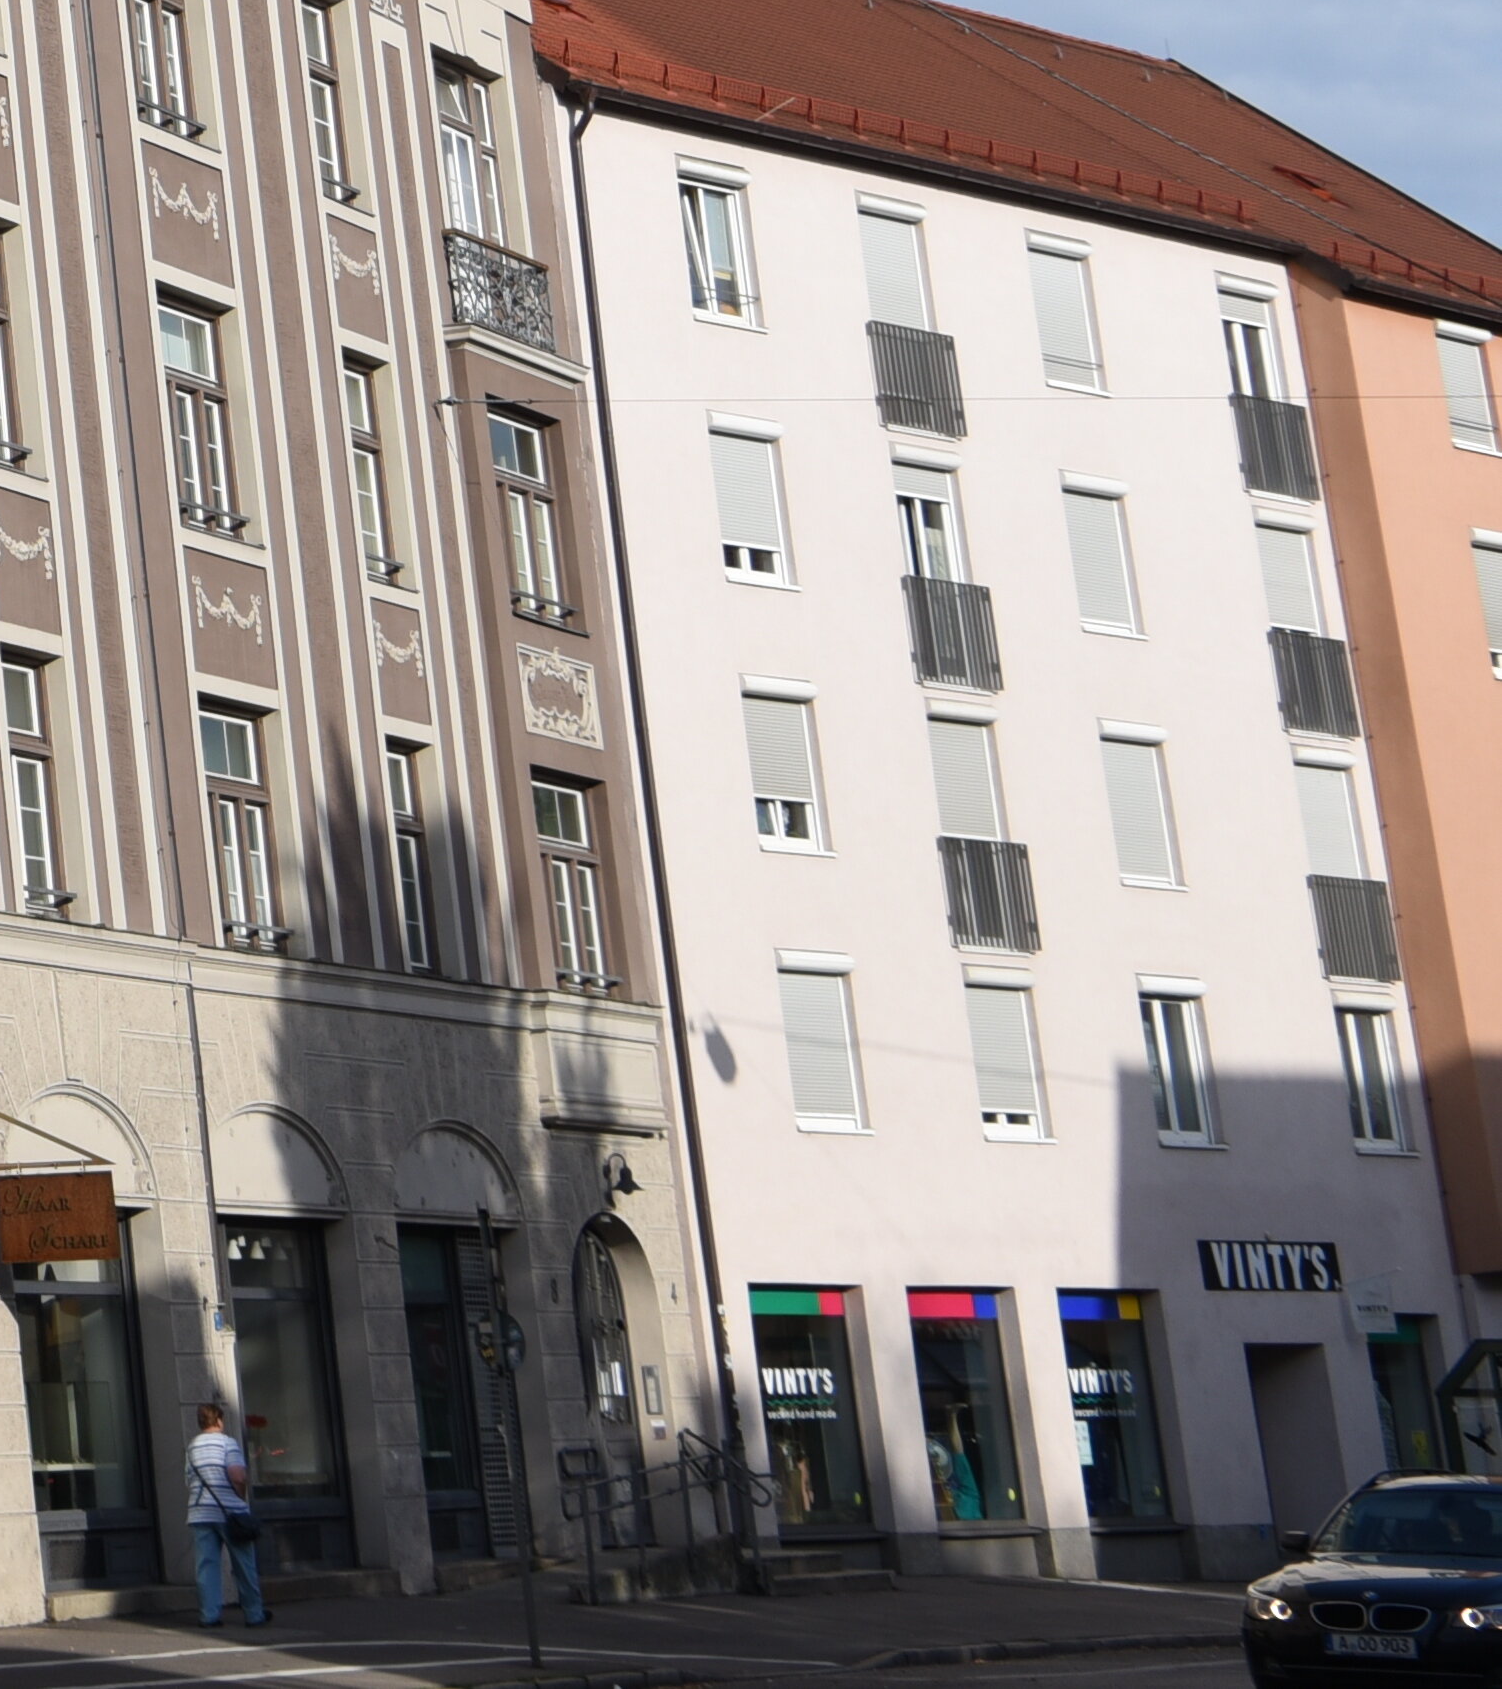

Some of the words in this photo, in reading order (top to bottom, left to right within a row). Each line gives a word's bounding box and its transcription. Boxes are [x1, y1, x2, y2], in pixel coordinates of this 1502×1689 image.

[1209, 1241, 1328, 1290] VINTY'S
[761, 1367, 833, 1394] VINTY'S
[1067, 1368, 1132, 1393] VINTY'S
